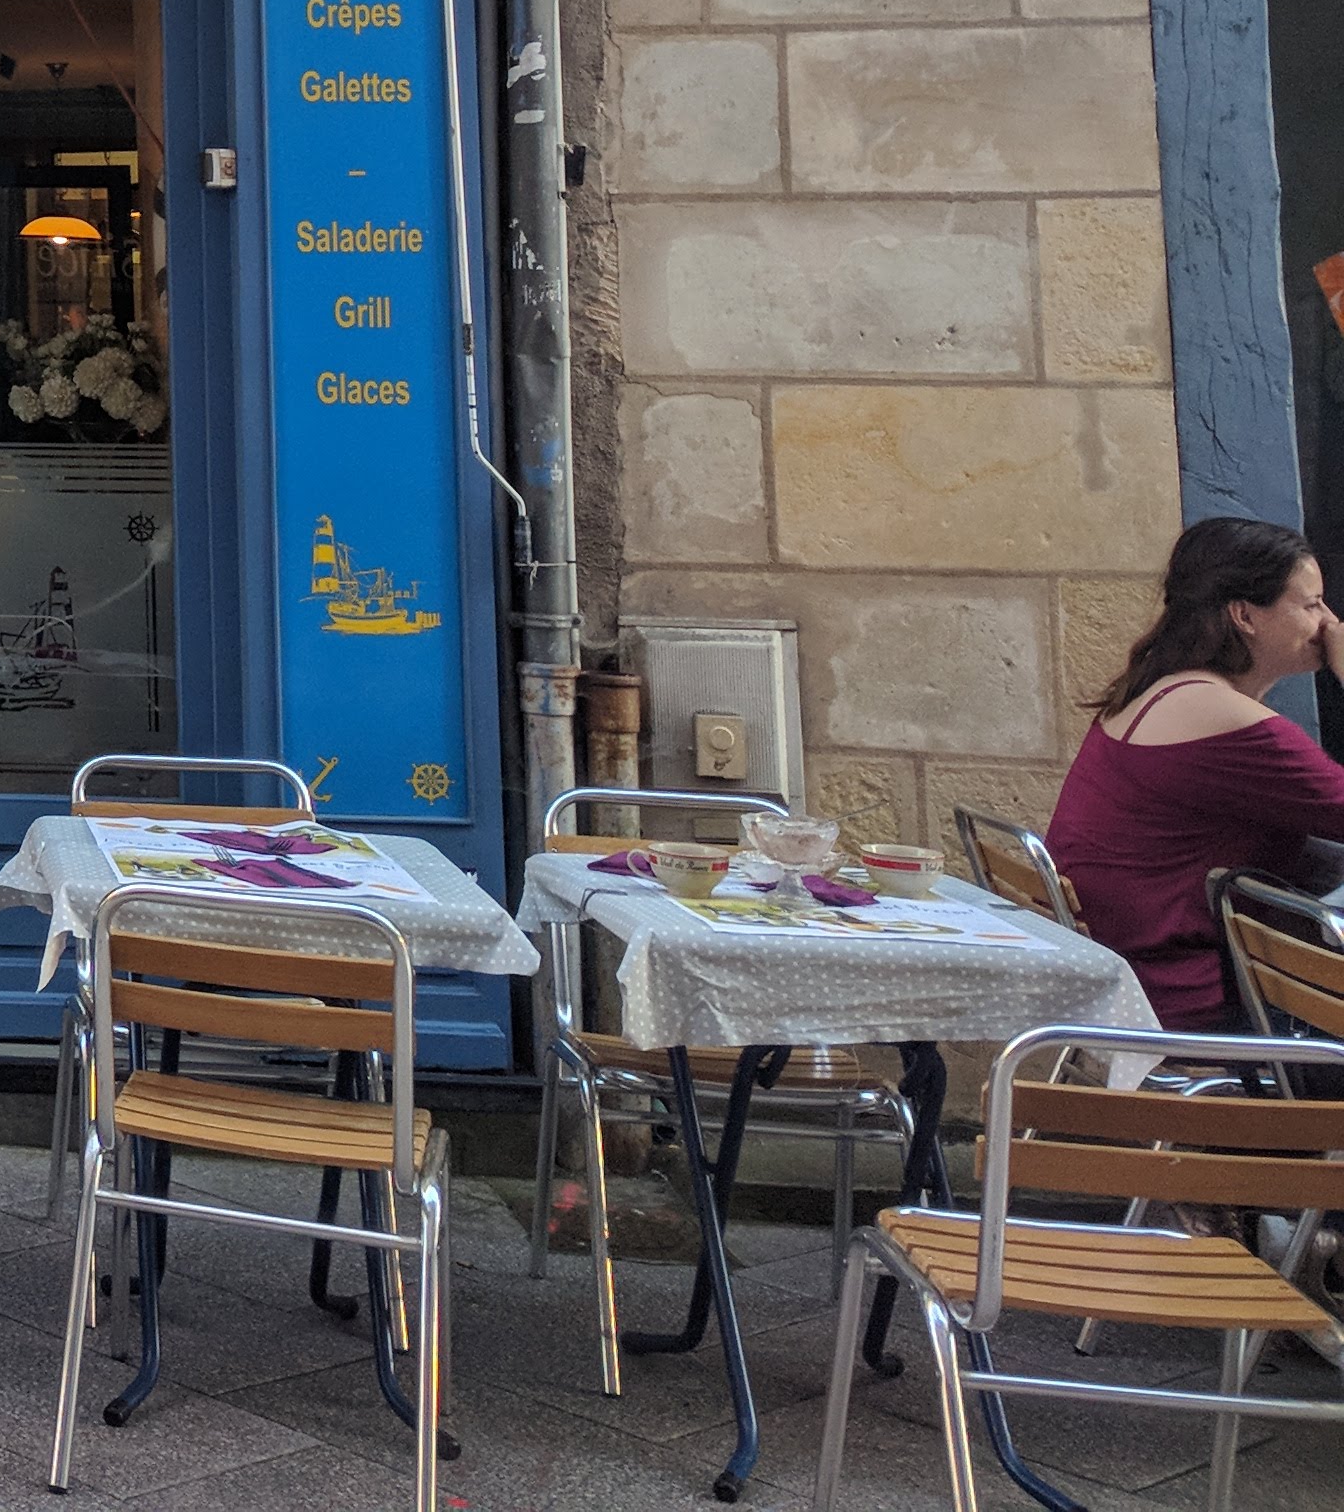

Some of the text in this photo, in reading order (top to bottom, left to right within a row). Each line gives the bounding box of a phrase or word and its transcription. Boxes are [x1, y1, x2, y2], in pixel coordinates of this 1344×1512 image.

[300, 70, 412, 104] Galettes
[296, 220, 422, 254] Saladerie
[333, 295, 392, 329] Grill
[315, 371, 410, 406] Glaces
